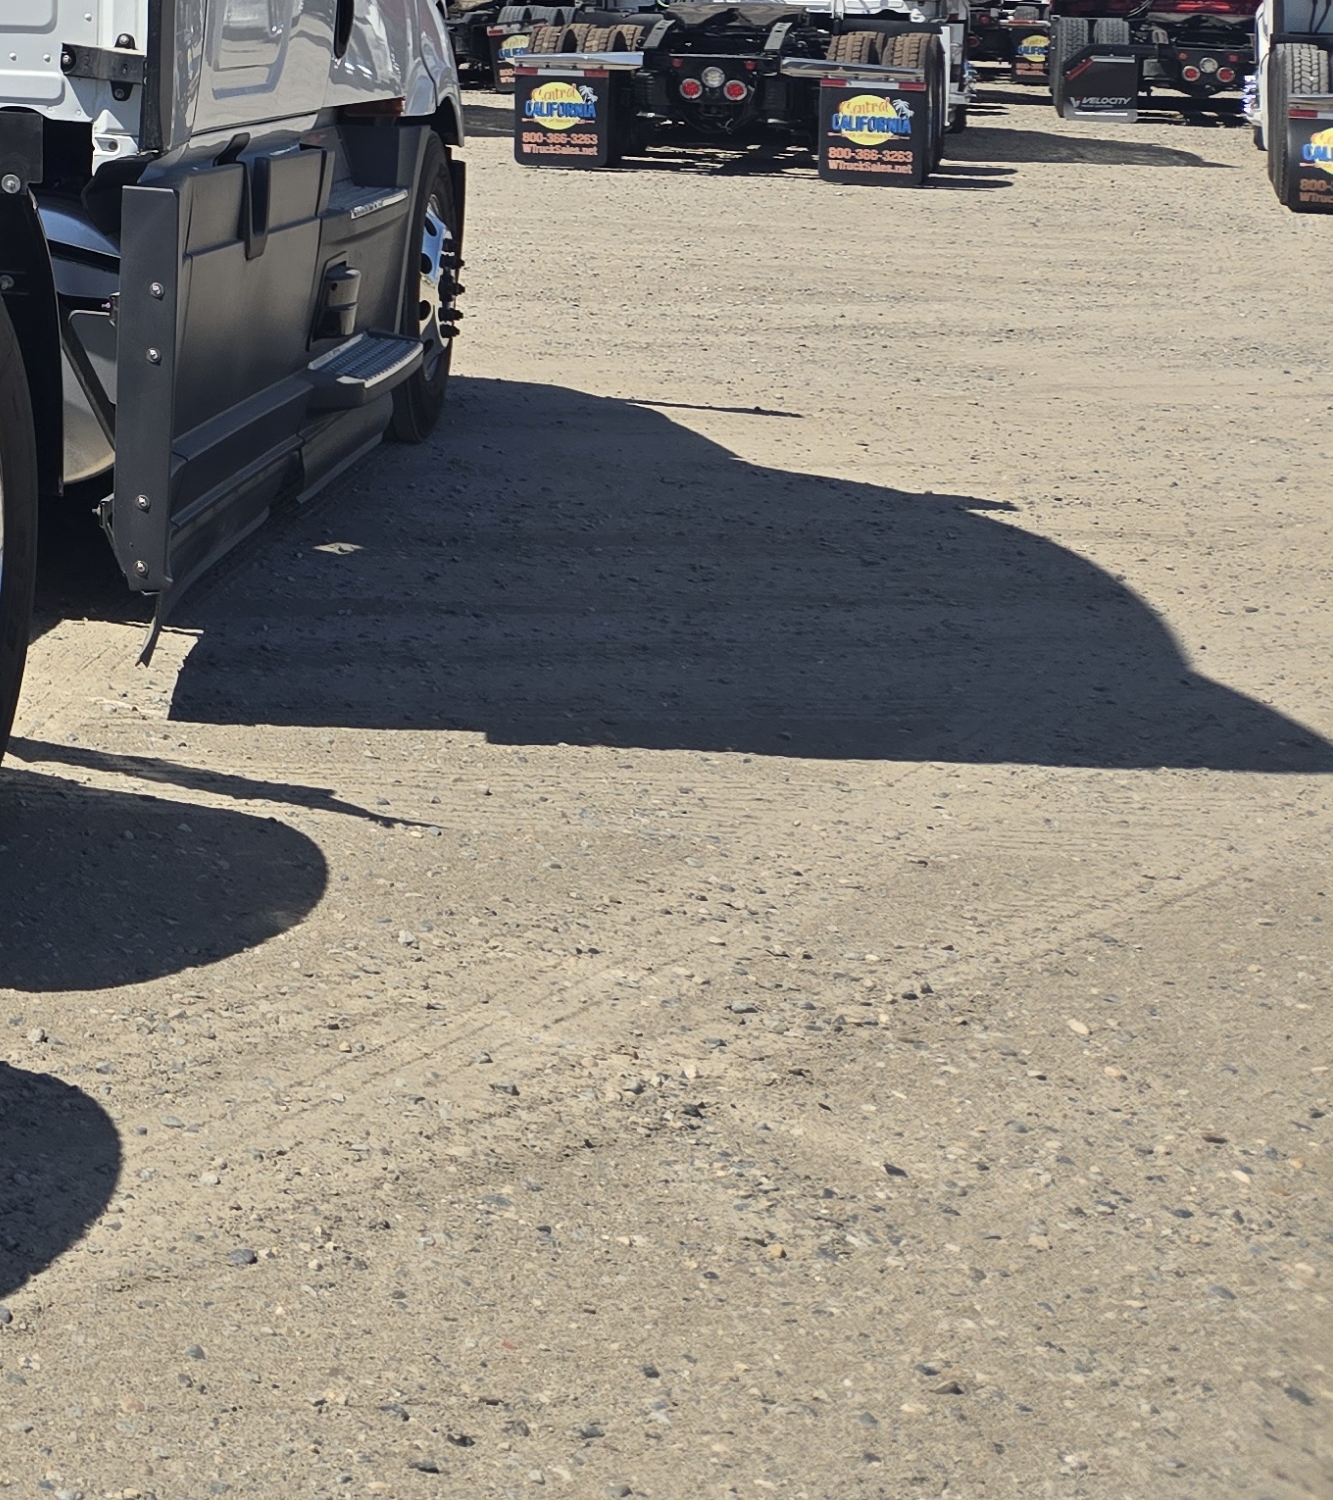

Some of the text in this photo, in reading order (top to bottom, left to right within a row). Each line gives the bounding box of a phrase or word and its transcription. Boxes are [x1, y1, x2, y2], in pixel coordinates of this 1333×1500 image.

[525, 99, 596, 118] CALIFORNIA
[1081, 96, 1132, 105] VELOCITY
[831, 113, 912, 134] CALIFORNIA
